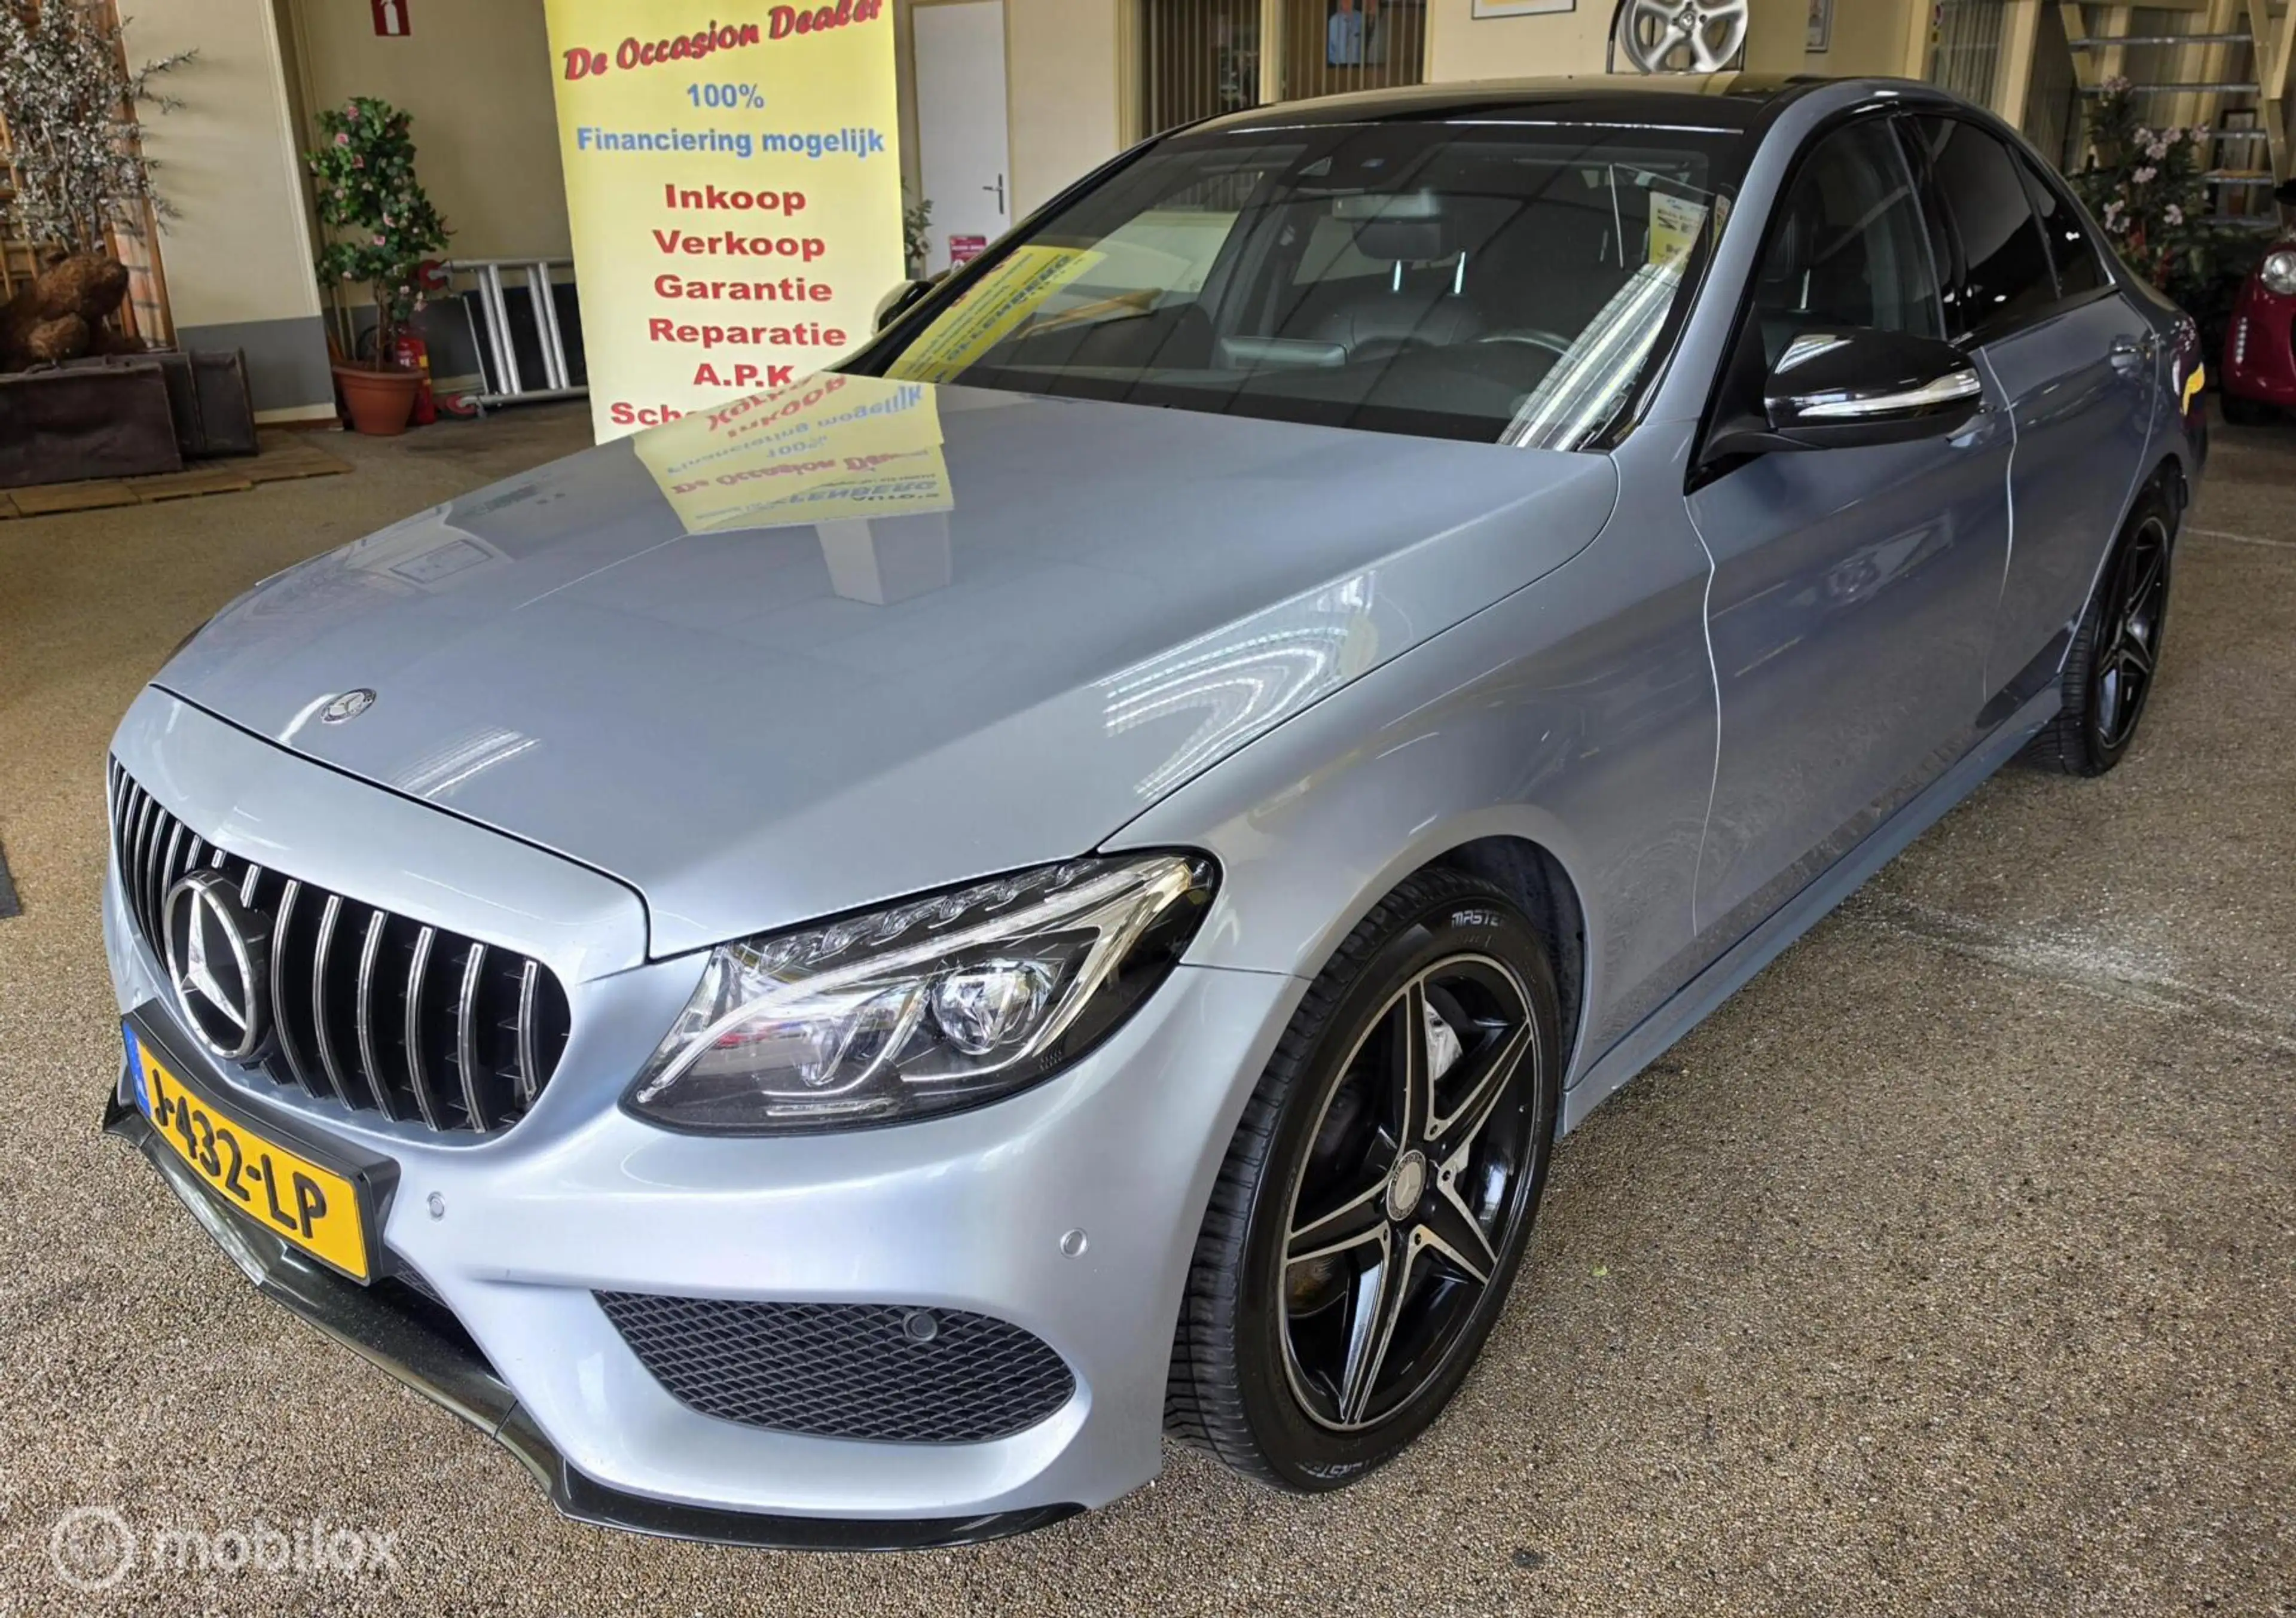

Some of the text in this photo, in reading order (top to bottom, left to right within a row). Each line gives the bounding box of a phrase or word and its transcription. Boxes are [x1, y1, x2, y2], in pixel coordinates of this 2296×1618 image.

[564, 0, 883, 81] De Occasion Dealer
[688, 84, 764, 109] 100%
[578, 128, 885, 158] Financiering mogelijk
[665, 184, 806, 216] Inkoop
[653, 230, 826, 262] Verkoop
[654, 275, 833, 301] Garantie
[649, 318, 847, 349] Reparatie
[694, 364, 795, 387] A.P.K
[611, 402, 697, 426] Sch
[152, 1069, 327, 1239] J-432-LP
